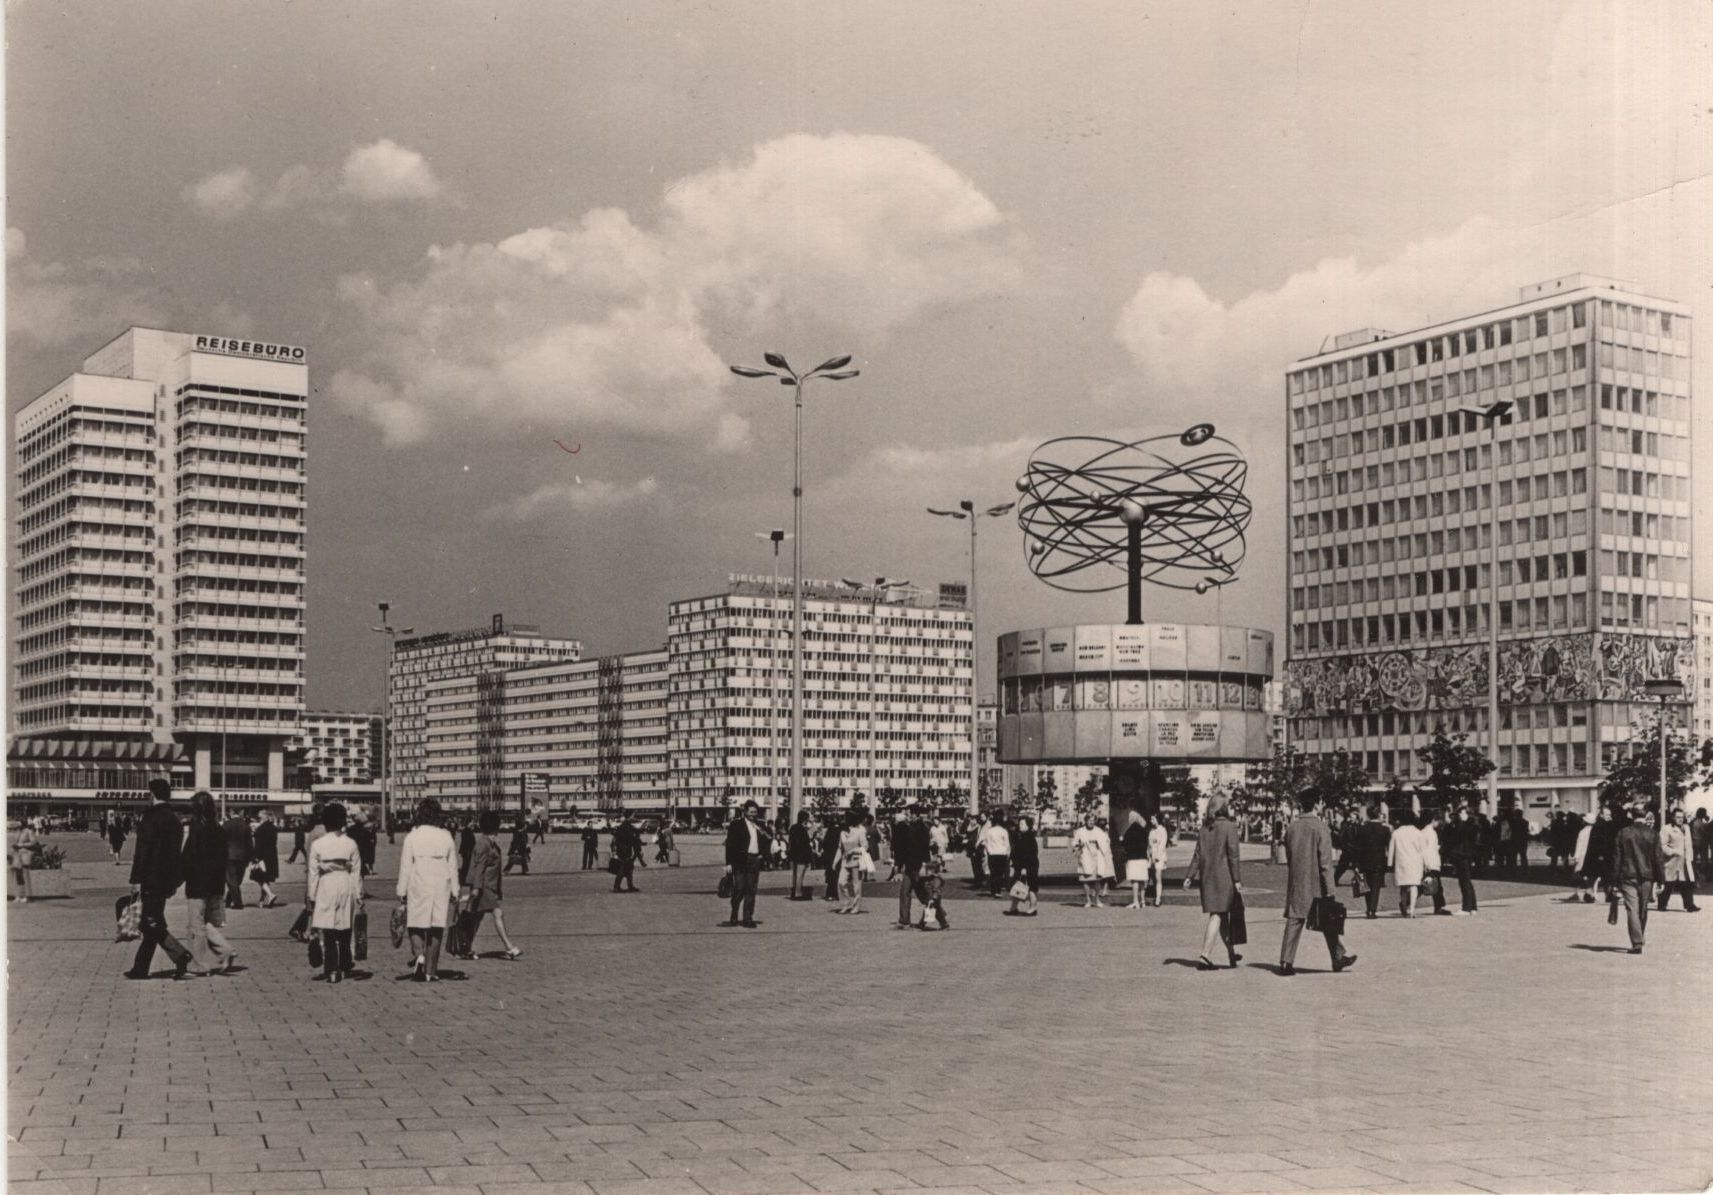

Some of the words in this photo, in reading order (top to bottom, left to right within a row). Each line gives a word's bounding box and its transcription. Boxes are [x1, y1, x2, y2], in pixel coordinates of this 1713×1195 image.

[196, 336, 305, 358] REISEBÜRO
[1059, 684, 1072, 704] 7
[1093, 683, 1109, 703] 8
[1128, 683, 1142, 703] 9
[1157, 683, 1182, 702] 10
[1194, 683, 1213, 703] 11
[1222, 683, 1241, 703] 12
